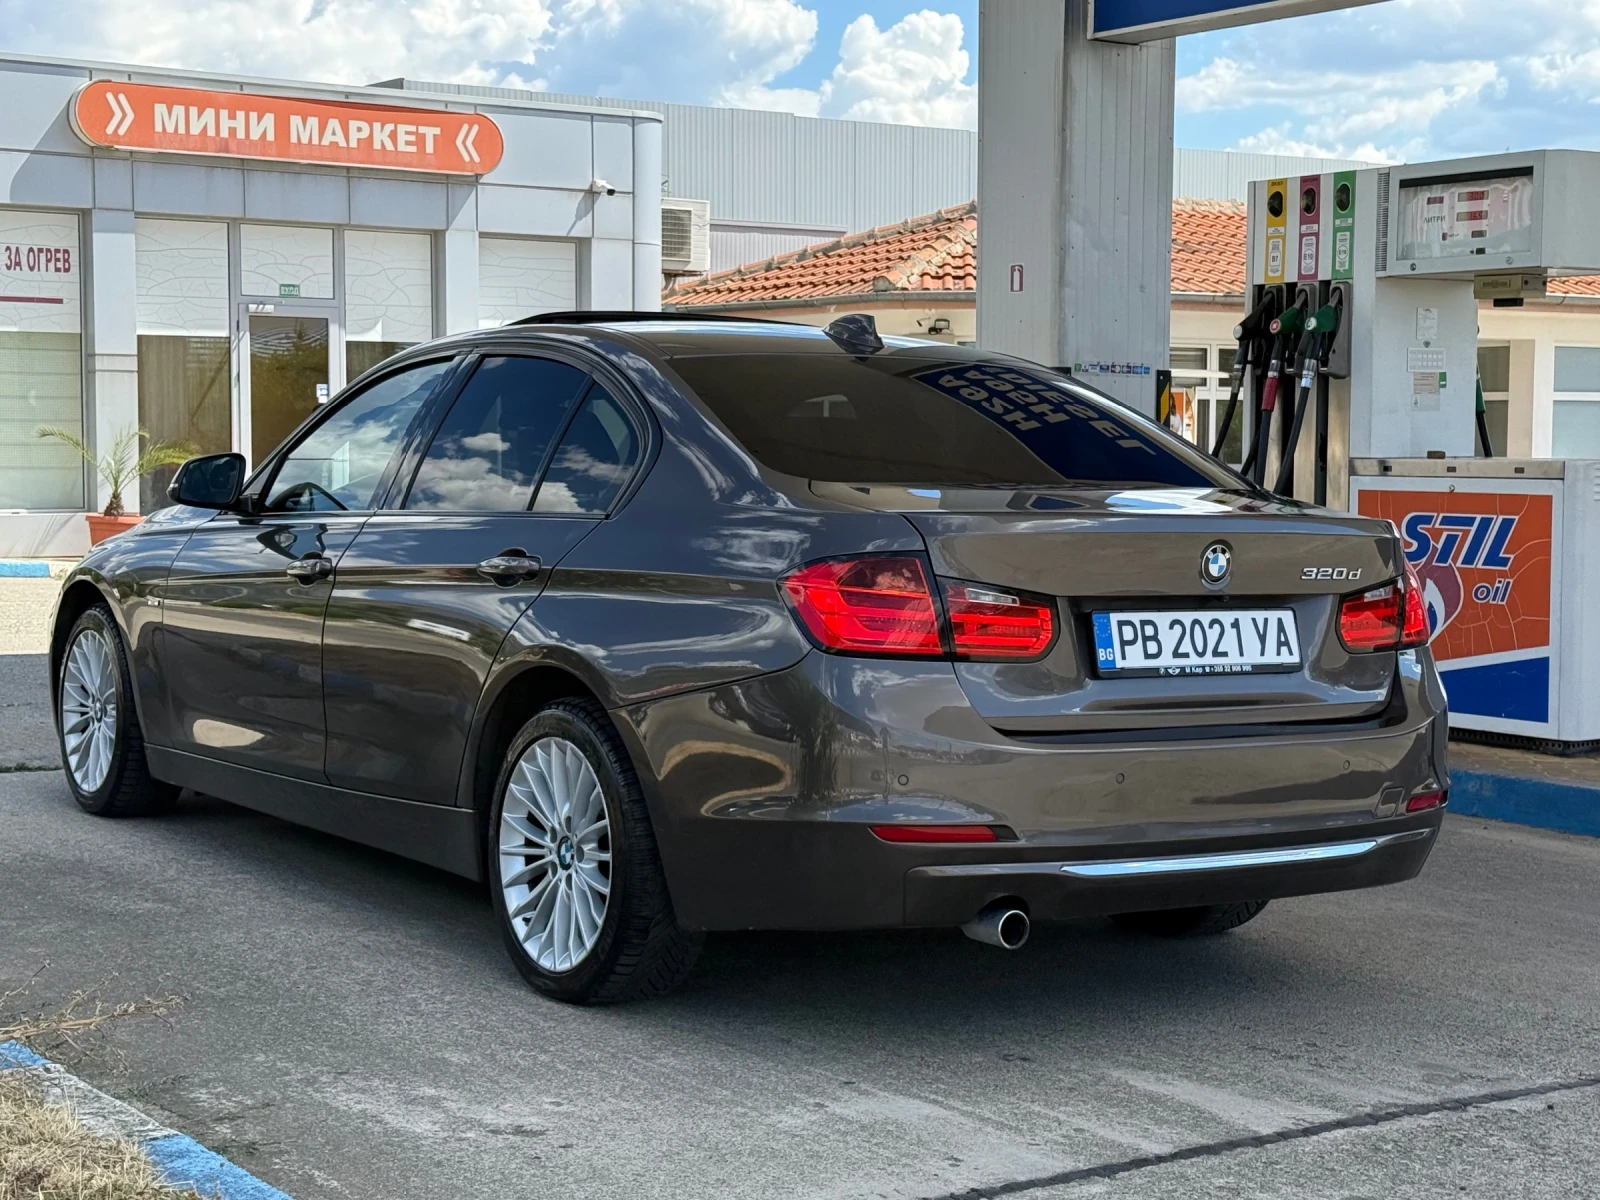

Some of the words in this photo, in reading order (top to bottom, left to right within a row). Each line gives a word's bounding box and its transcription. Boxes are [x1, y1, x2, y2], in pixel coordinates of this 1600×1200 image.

[153, 103, 275, 142] МИНИ
[289, 114, 441, 154] МАРКЕТ
[1424, 215, 1446, 224] ЛИТРИ
[5, 246, 23, 271] ЗА
[27, 246, 71, 273] ОГРЕВ
[280, 286, 299, 296] ВХОД
[1301, 567, 1362, 580] 320d
[1472, 578, 1513, 605] oil
[1117, 619, 1163, 660] PB
[1168, 617, 1245, 659] 2021
[1250, 617, 1294, 657] YA
[1099, 648, 1114, 661] BG
